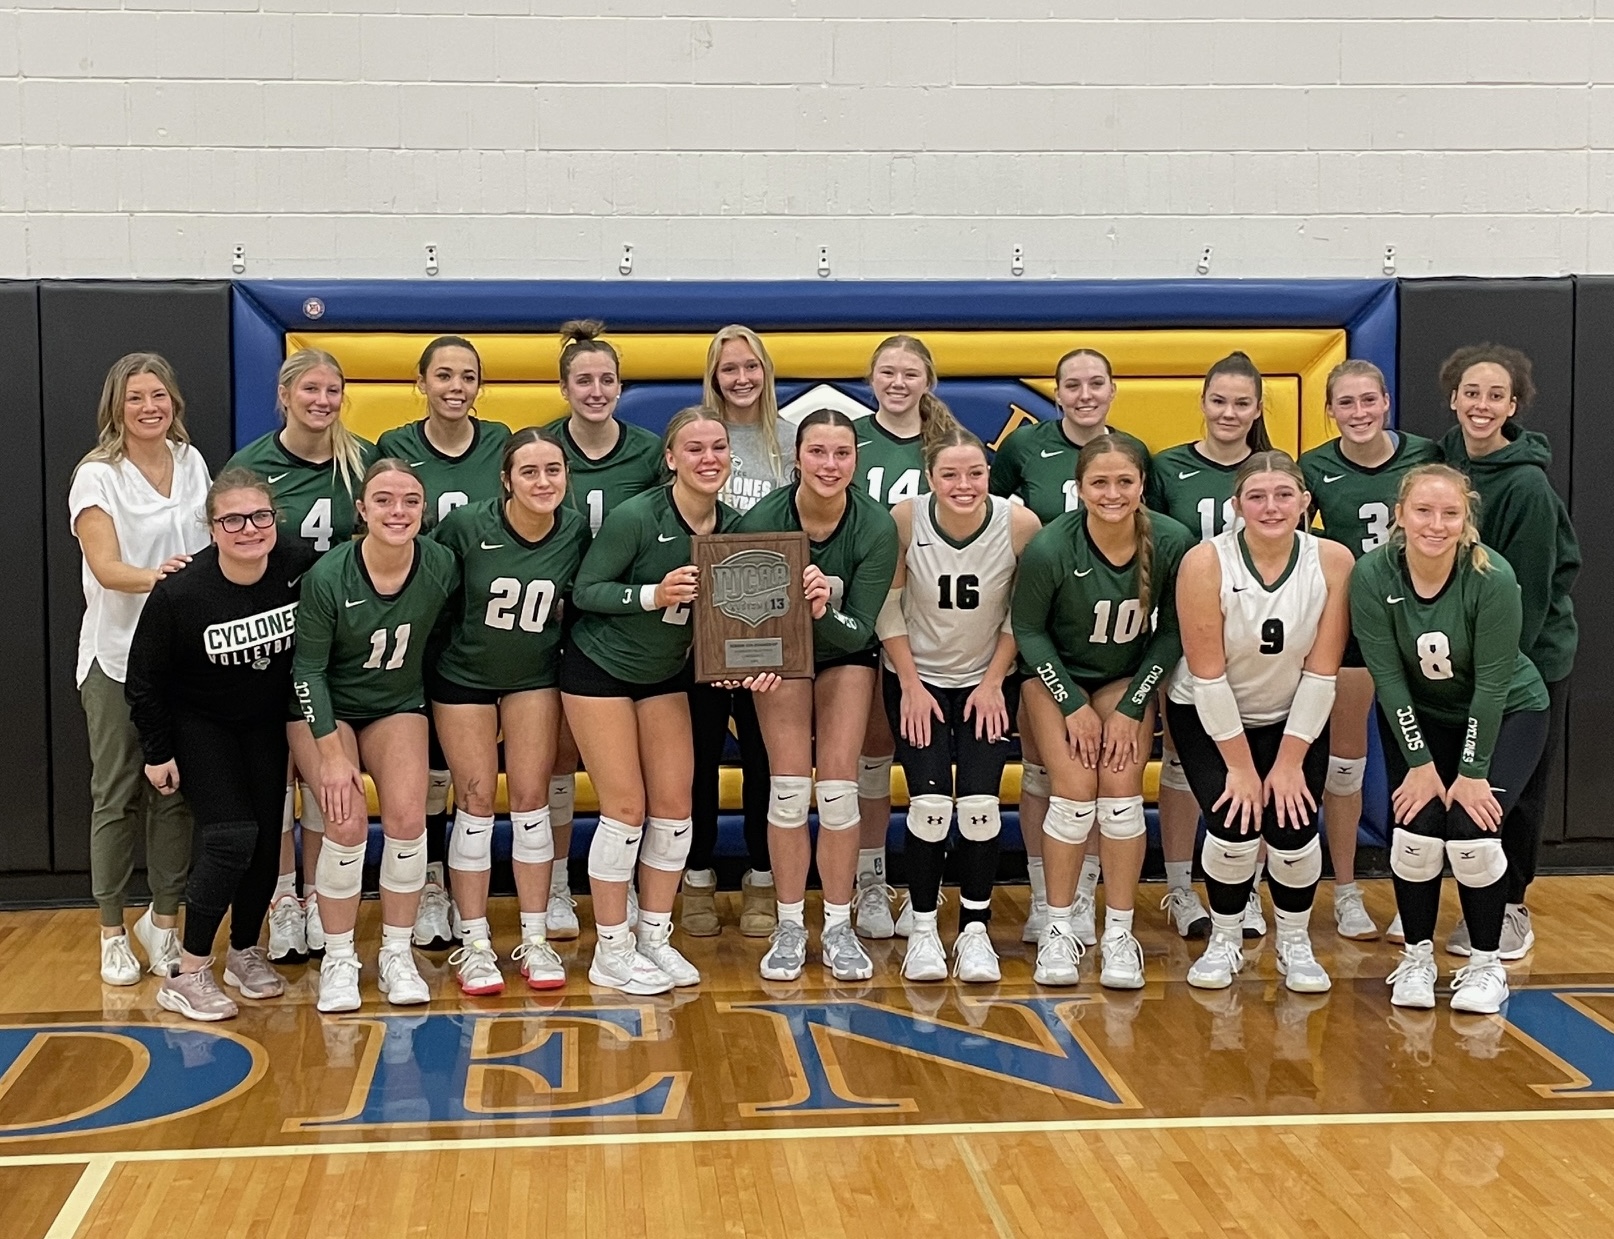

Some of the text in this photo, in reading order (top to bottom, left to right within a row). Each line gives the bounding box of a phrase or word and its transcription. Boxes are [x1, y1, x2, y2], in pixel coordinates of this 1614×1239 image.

[867, 467, 921, 504] 14
[301, 498, 333, 551] 4
[1358, 502, 1389, 553] 3
[714, 564, 786, 600] NJCAA
[771, 598, 785, 610] 13
[938, 574, 979, 610] 16
[485, 577, 555, 633] 20
[1089, 599, 1144, 644] 10
[363, 623, 411, 670] 11
[1259, 618, 1284, 654] 9
[1417, 631, 1454, 680] 8
[1036, 662, 1069, 703] SCTCC
[1131, 664, 1164, 705] CYCLONES
[1396, 705, 1425, 751] SCTCC
[1462, 716, 1479, 763] CYCLONES
